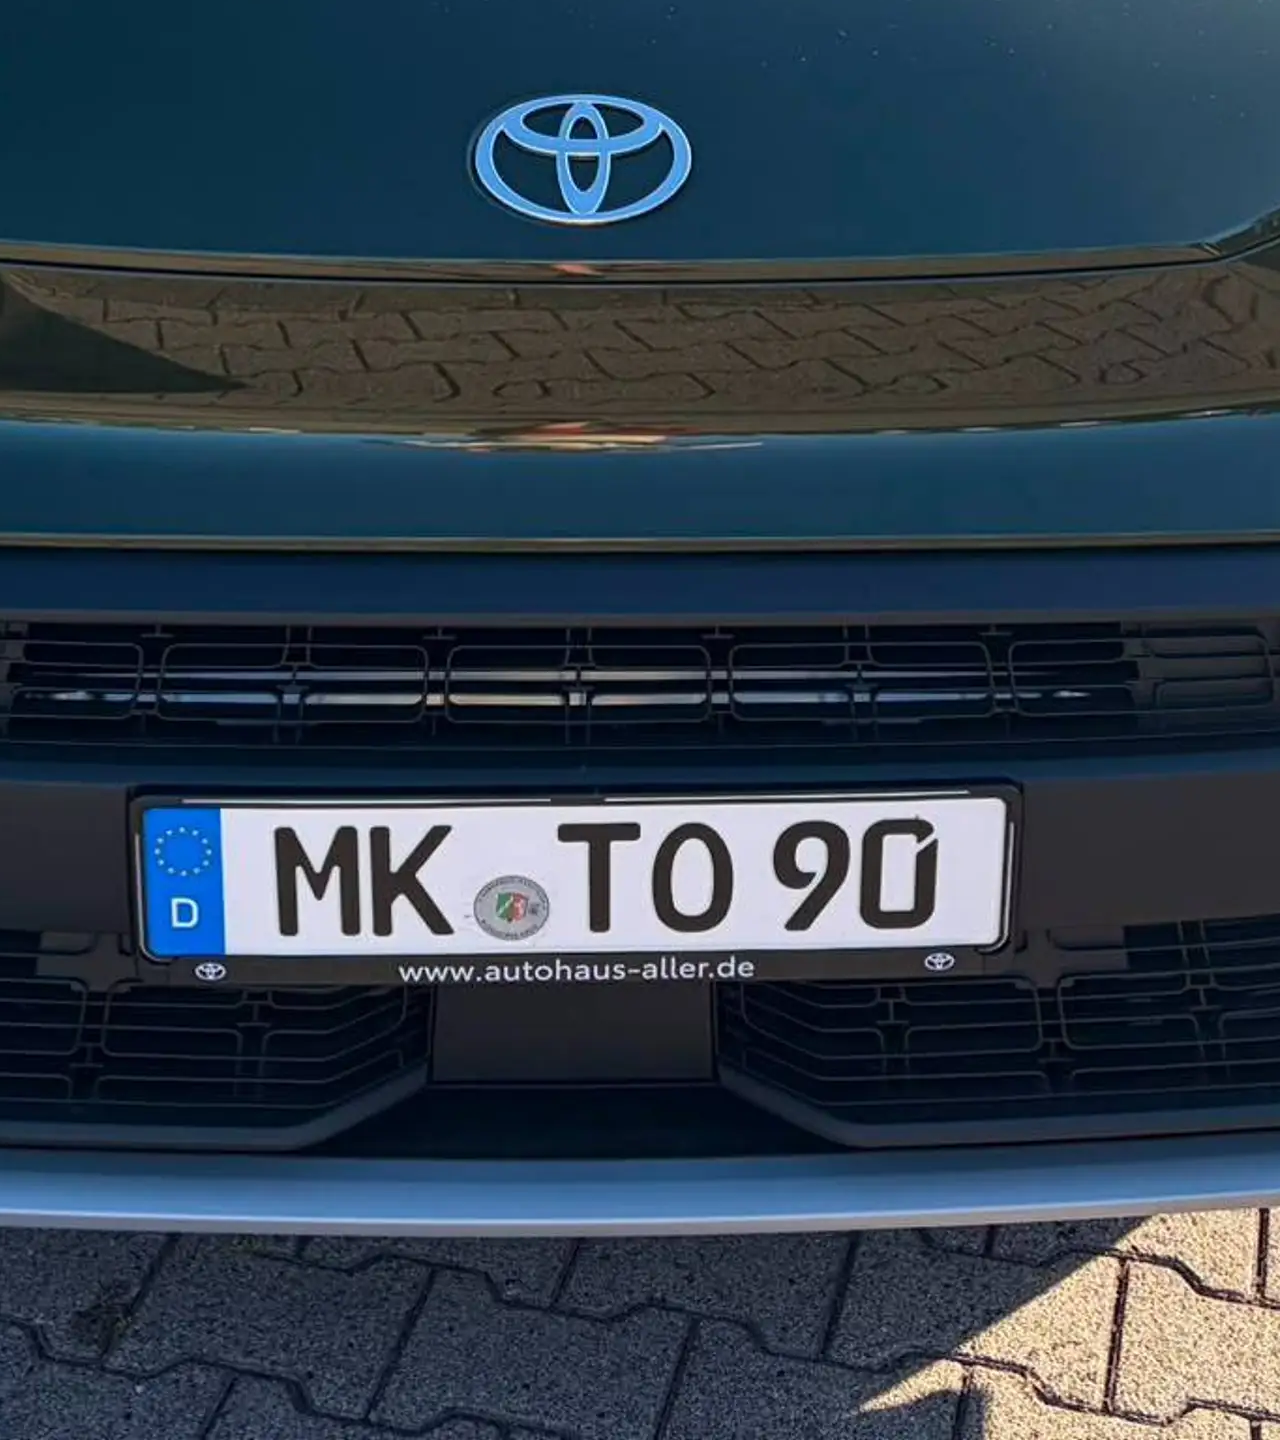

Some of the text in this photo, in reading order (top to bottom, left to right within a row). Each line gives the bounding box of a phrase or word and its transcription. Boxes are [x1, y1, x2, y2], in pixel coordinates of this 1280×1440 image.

[274, 825, 454, 937] MK
[557, 822, 734, 933] TO
[772, 817, 939, 931] 90
[171, 898, 198, 927] D
[398, 955, 754, 983] www.autohaus-aller.de
